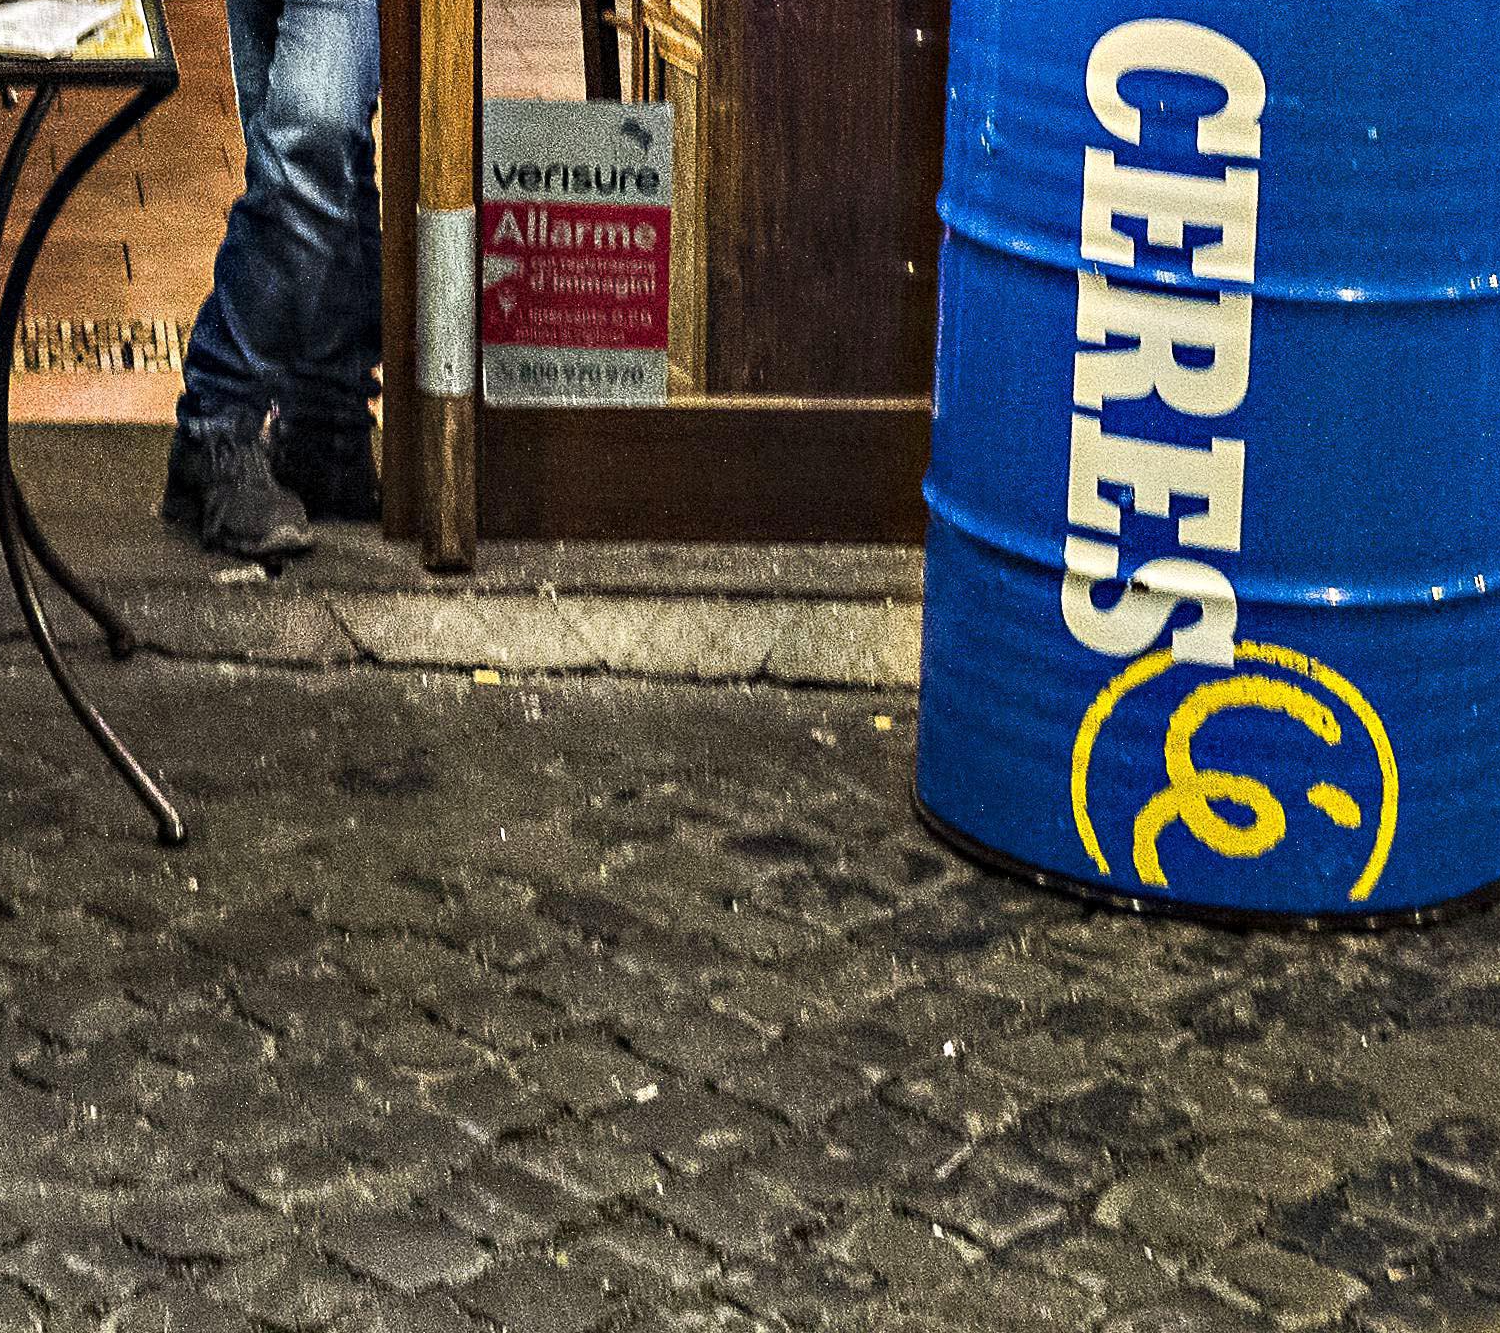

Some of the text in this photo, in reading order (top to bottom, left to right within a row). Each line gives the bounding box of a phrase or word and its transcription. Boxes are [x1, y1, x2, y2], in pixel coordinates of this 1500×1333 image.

[492, 162, 660, 195] verisure
[491, 207, 657, 250] Allarme
[1060, 16, 1268, 669] CERES
